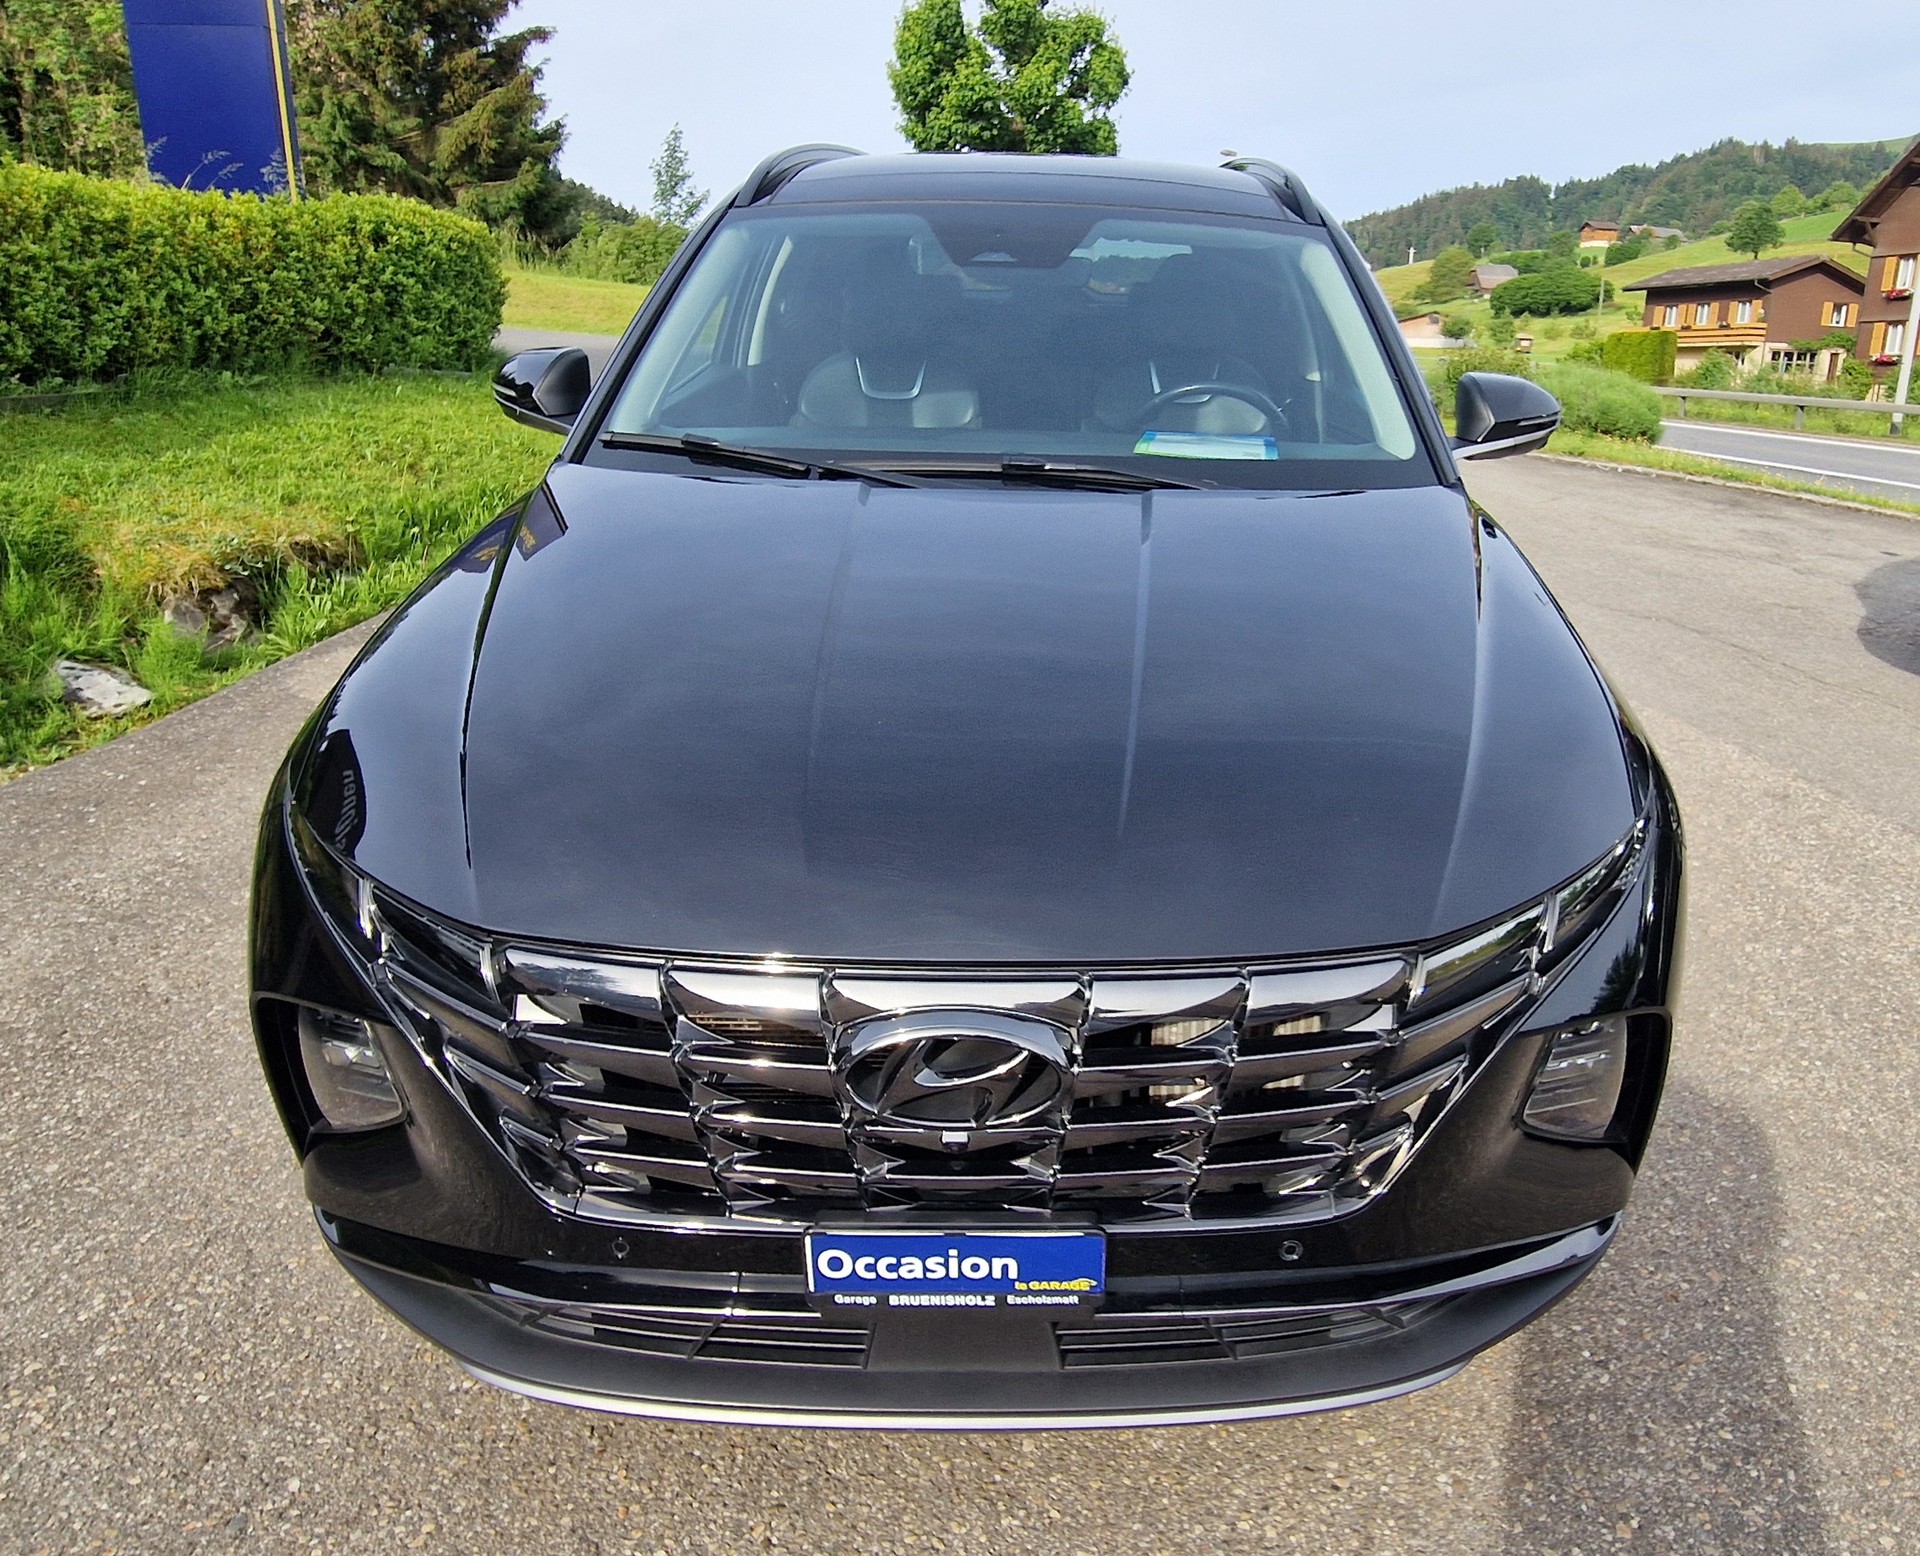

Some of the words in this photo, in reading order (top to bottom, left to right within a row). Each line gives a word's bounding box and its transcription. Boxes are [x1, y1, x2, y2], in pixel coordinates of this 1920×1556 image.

[817, 1249, 1019, 1280] Occasion
[1029, 1281, 1091, 1291] GARAGE
[834, 1294, 877, 1306] Garage
[888, 1294, 996, 1307] BRUENISHOLZ
[1006, 1294, 1080, 1306] Escholzmatt
